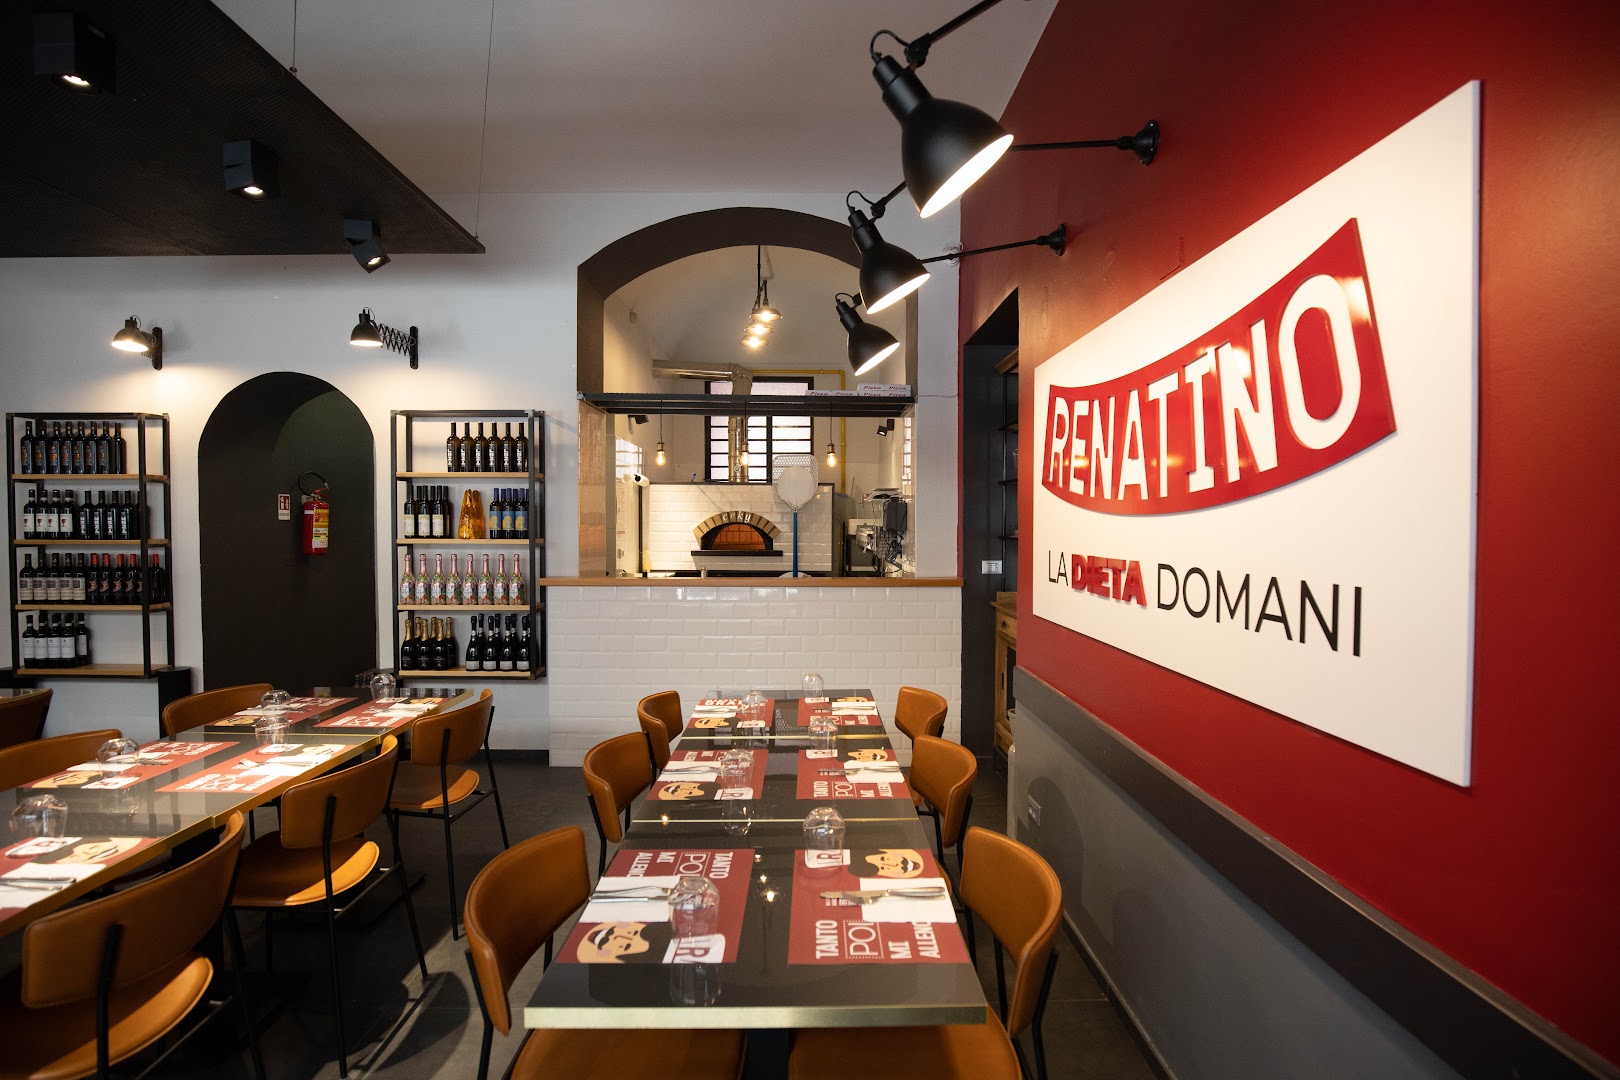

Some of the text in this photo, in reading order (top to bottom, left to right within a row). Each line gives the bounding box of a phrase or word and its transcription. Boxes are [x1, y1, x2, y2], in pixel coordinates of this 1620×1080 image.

[1049, 274, 1361, 500] RENATINO
[1048, 550, 1362, 657] LA DIETA DOMANI
[656, 851, 677, 864] MI
[709, 851, 734, 879] TANTO
[815, 919, 839, 960] TANTO
[888, 939, 912, 960] MI
